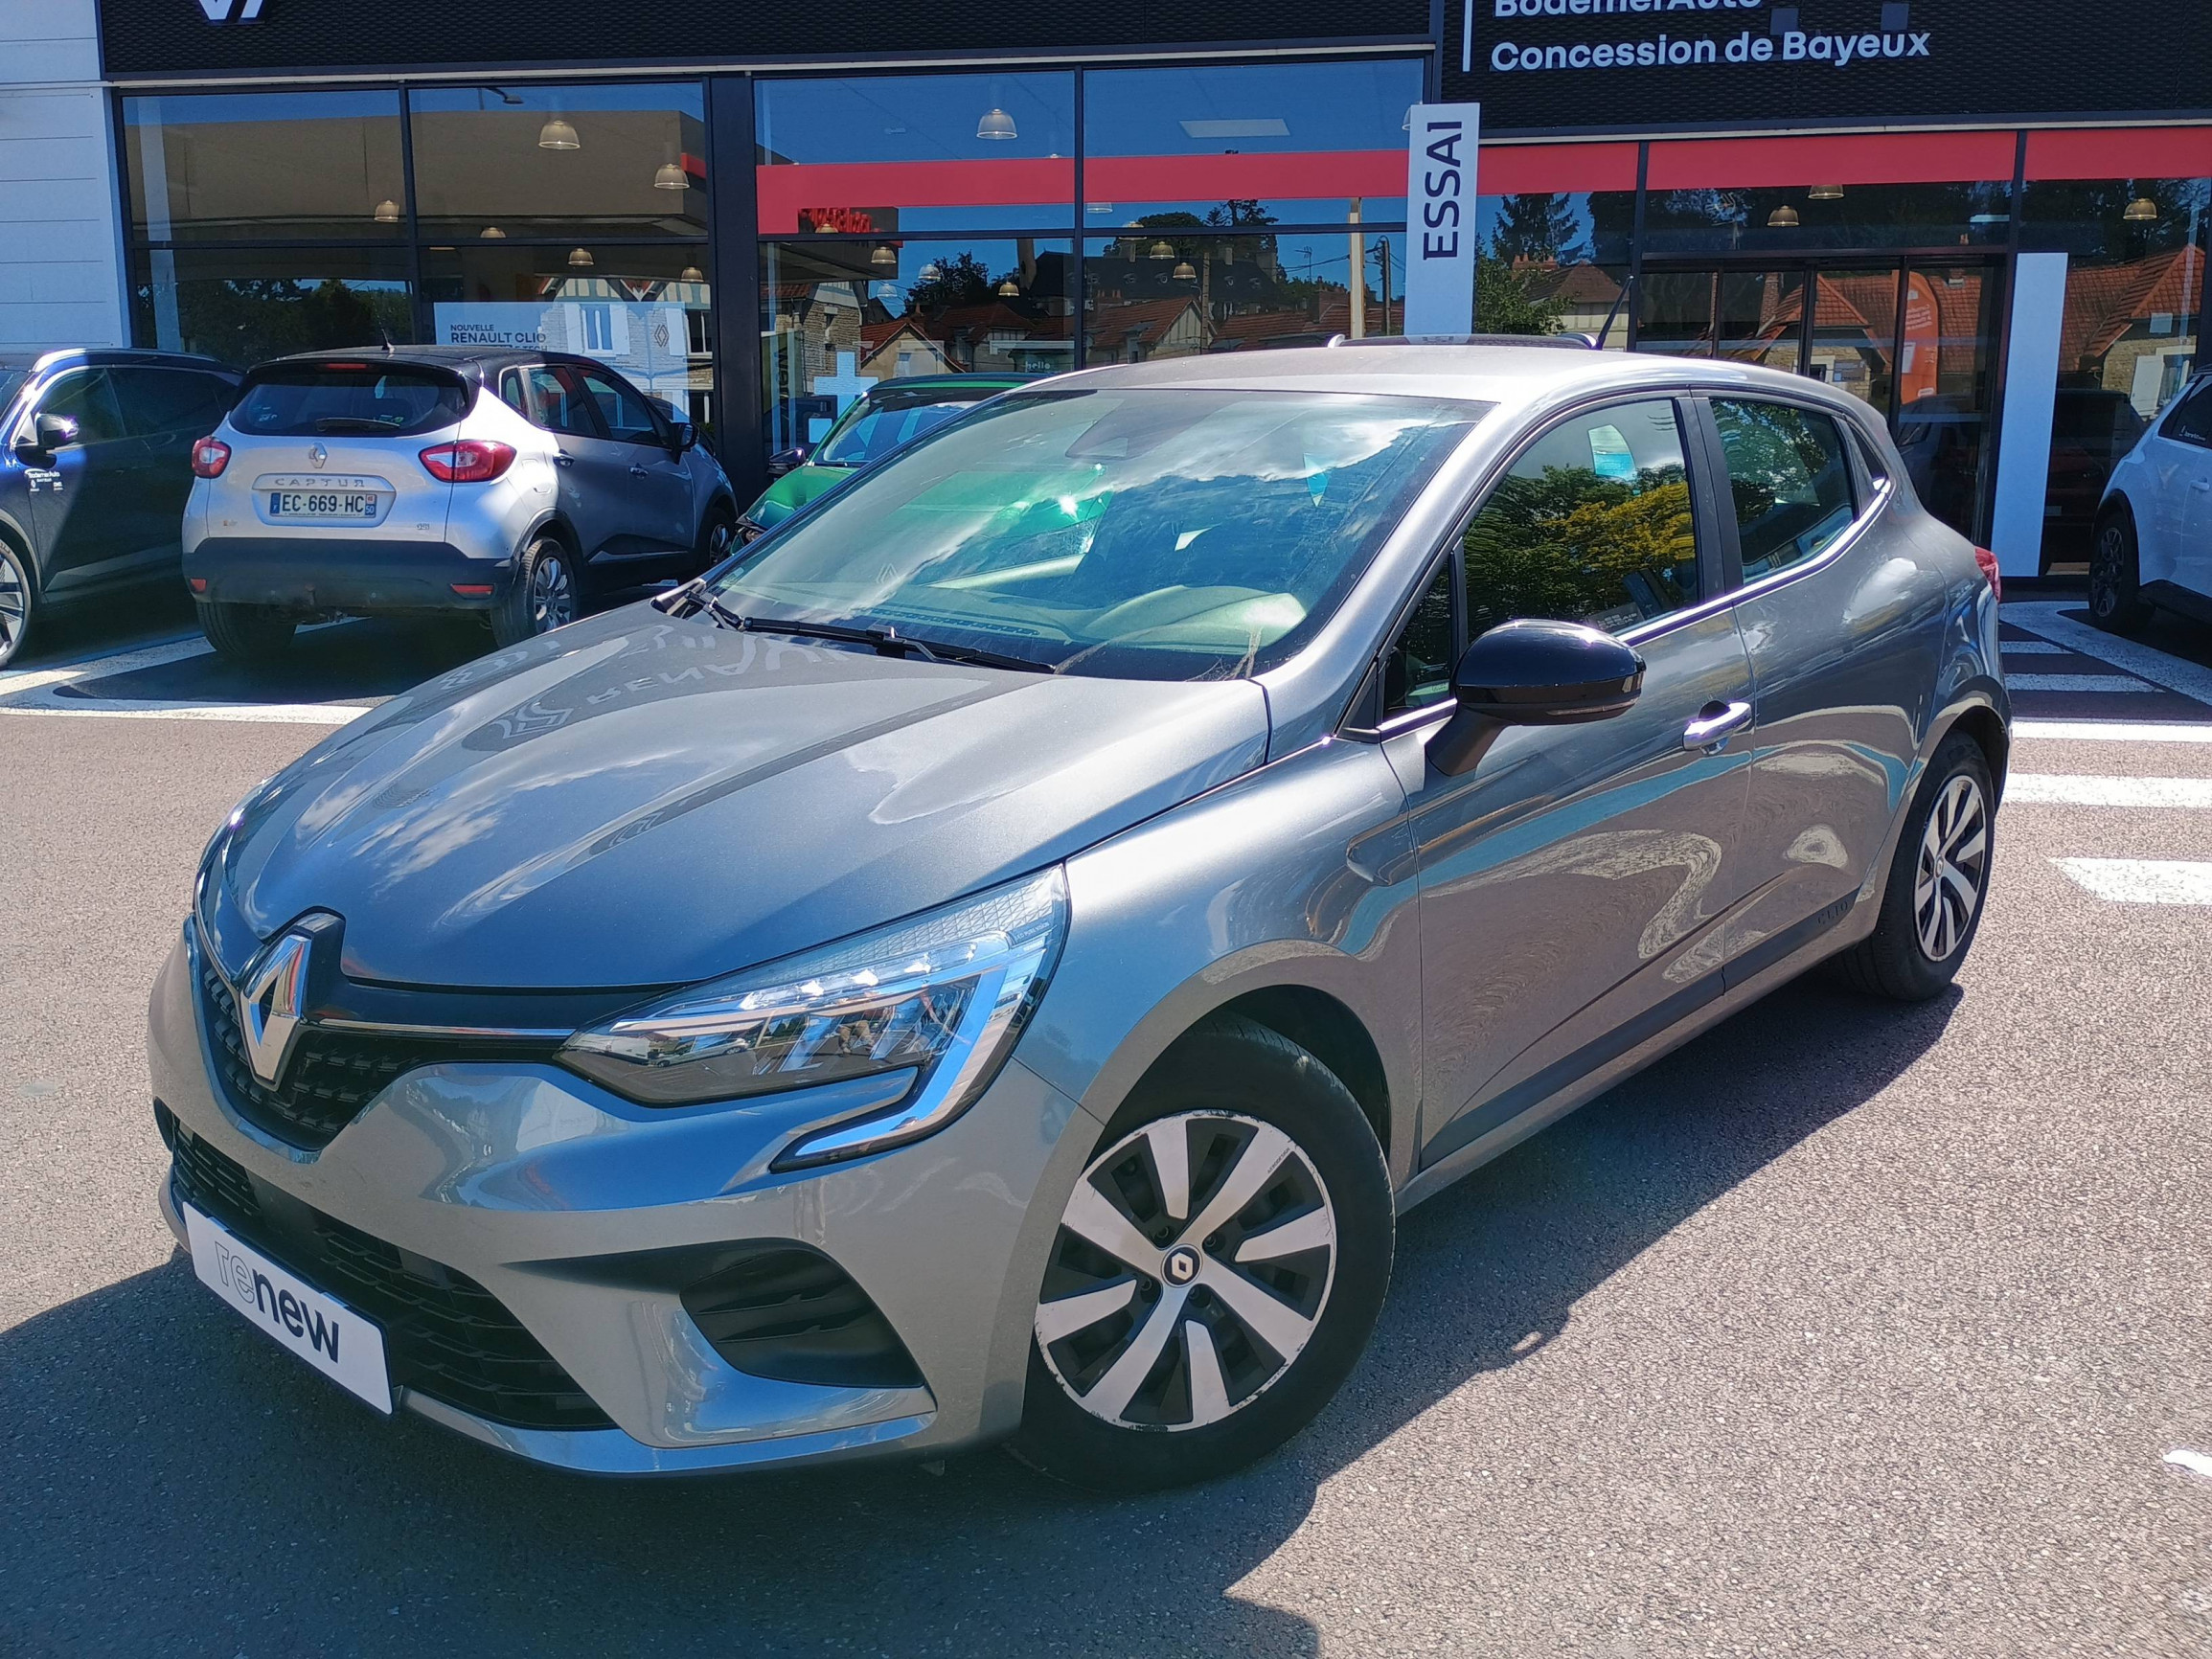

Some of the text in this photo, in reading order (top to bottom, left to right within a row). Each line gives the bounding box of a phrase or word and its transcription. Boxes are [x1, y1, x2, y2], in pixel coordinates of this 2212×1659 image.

[1491, 31, 1931, 72] Concession de Bayeux
[1423, 121, 1463, 261] ESSAI
[451, 332, 546, 344] RENAULT CLIO
[274, 478, 365, 488] CAPTUR
[282, 494, 364, 513] EC-669-HC
[365, 505, 375, 514] 50
[215, 1240, 340, 1365] renew
